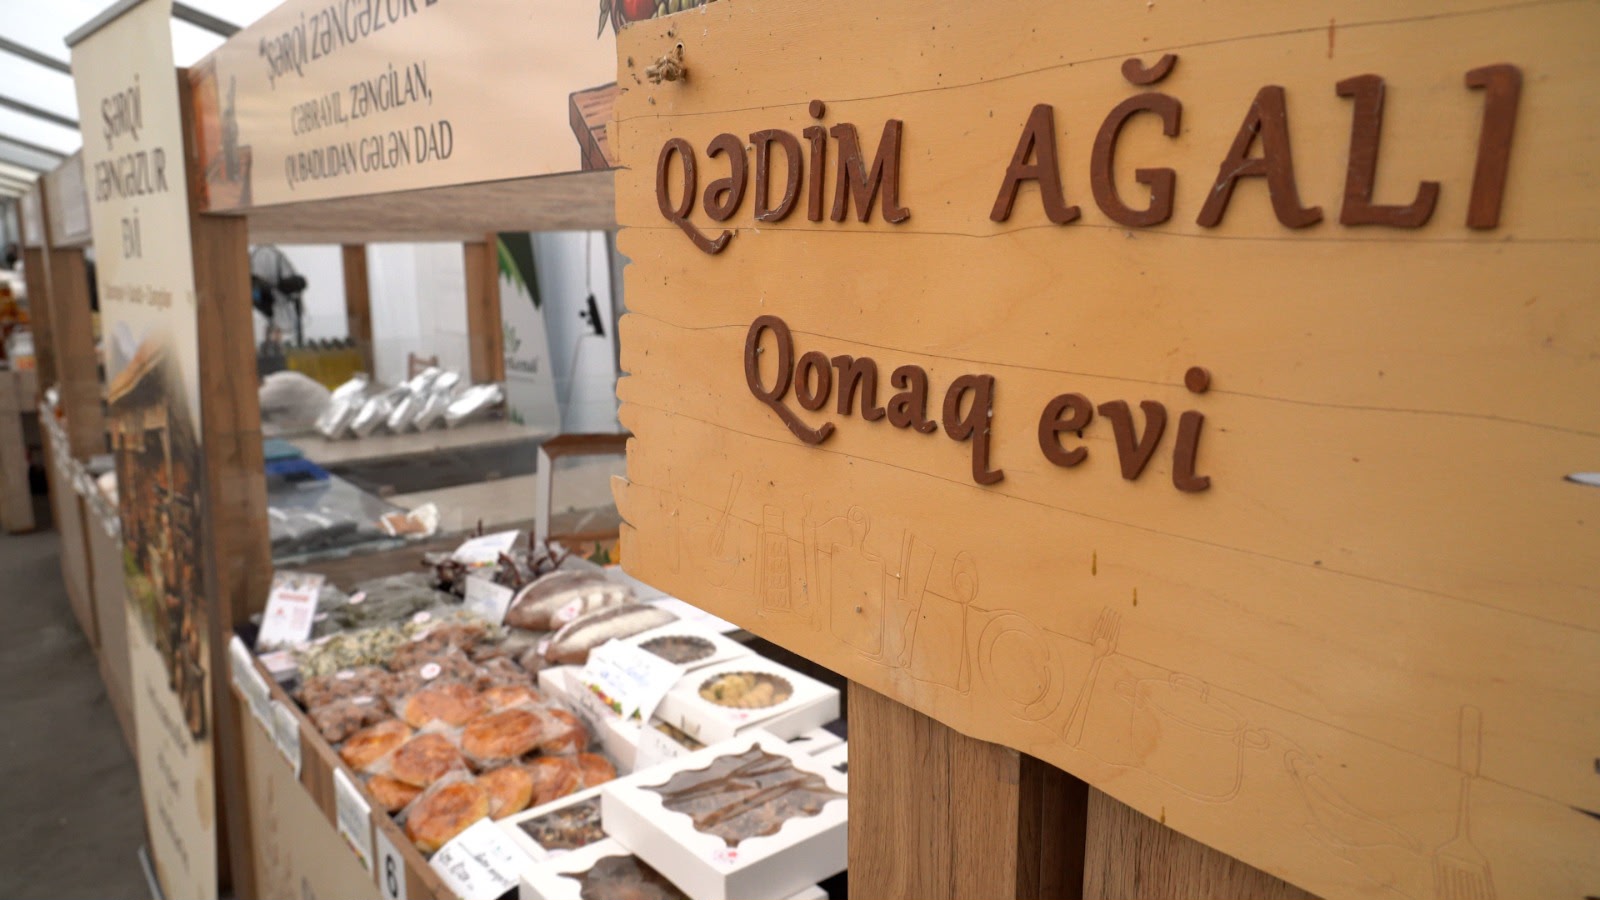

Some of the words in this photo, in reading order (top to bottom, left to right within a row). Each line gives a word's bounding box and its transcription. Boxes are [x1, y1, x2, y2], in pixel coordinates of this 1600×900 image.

[350, 60, 433, 120] ZƏNGİLAN,
[359, 129, 411, 173] GƏLƏN
[413, 120, 454, 164] DAD
[655, 99, 911, 255] QƏDİM
[989, 53, 1525, 231] AĞALI
[744, 315, 1005, 486] Qonaq
[1038, 365, 1212, 493] evi
